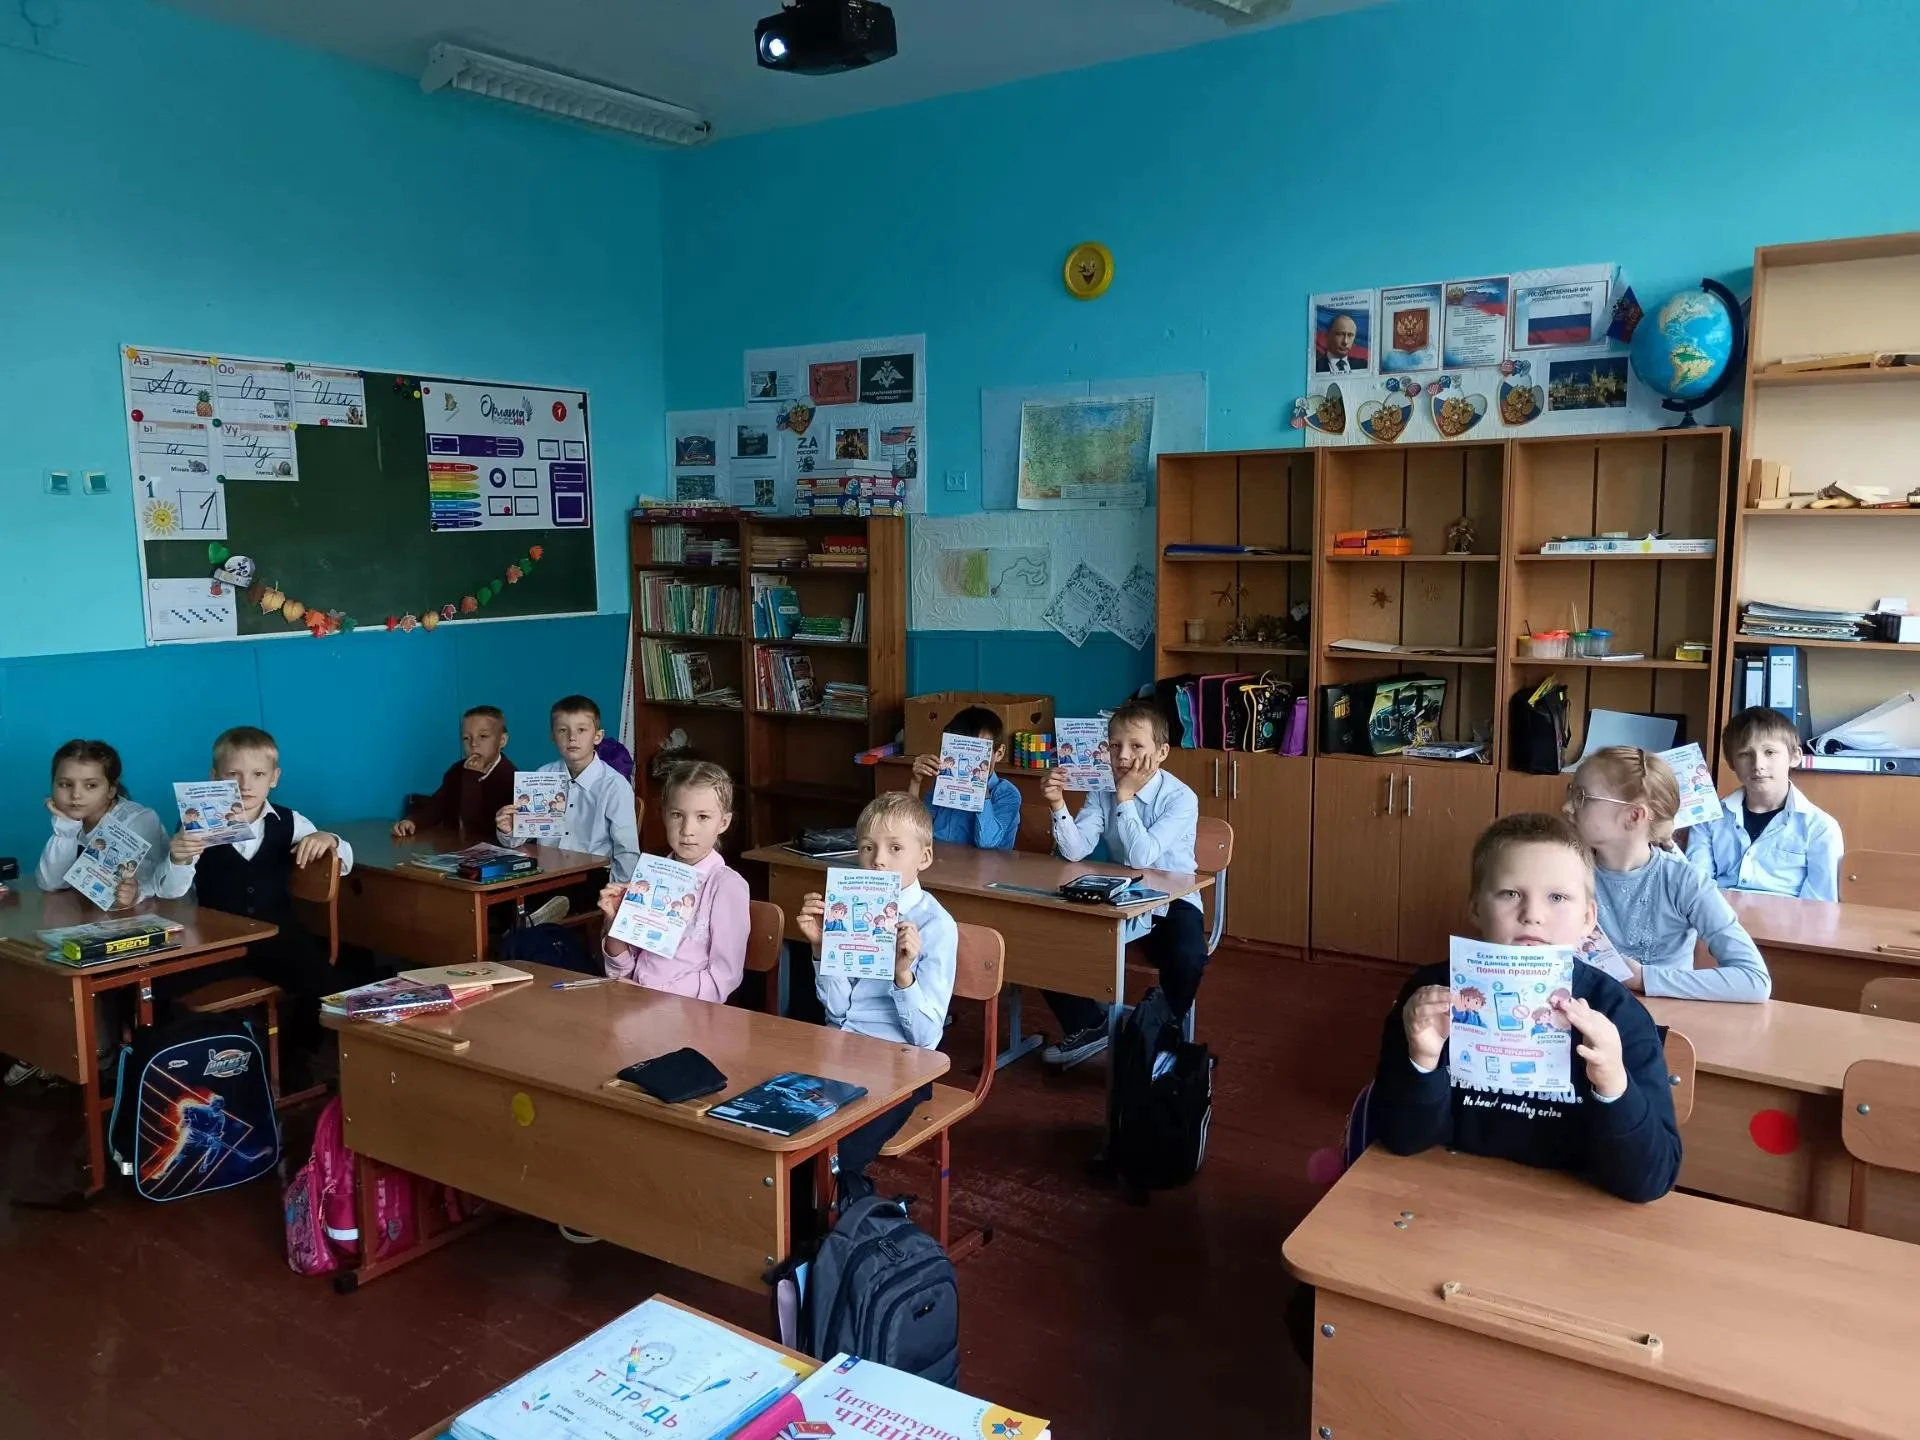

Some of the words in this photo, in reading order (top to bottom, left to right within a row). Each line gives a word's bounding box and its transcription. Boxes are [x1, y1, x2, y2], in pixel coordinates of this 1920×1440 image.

[1528, 288, 1578, 297] ГОСУДАРСТВЕННЫЙ
[133, 356, 150, 366] Аа
[218, 364, 235, 375] Оо
[296, 371, 311, 381] Ии
[225, 425, 238, 436] Уу
[146, 481, 155, 498] 1
[200, 491, 216, 529] 1
[587, 1369, 678, 1428] ТЕТРАДЬ
[584, 1396, 627, 1421] русскому
